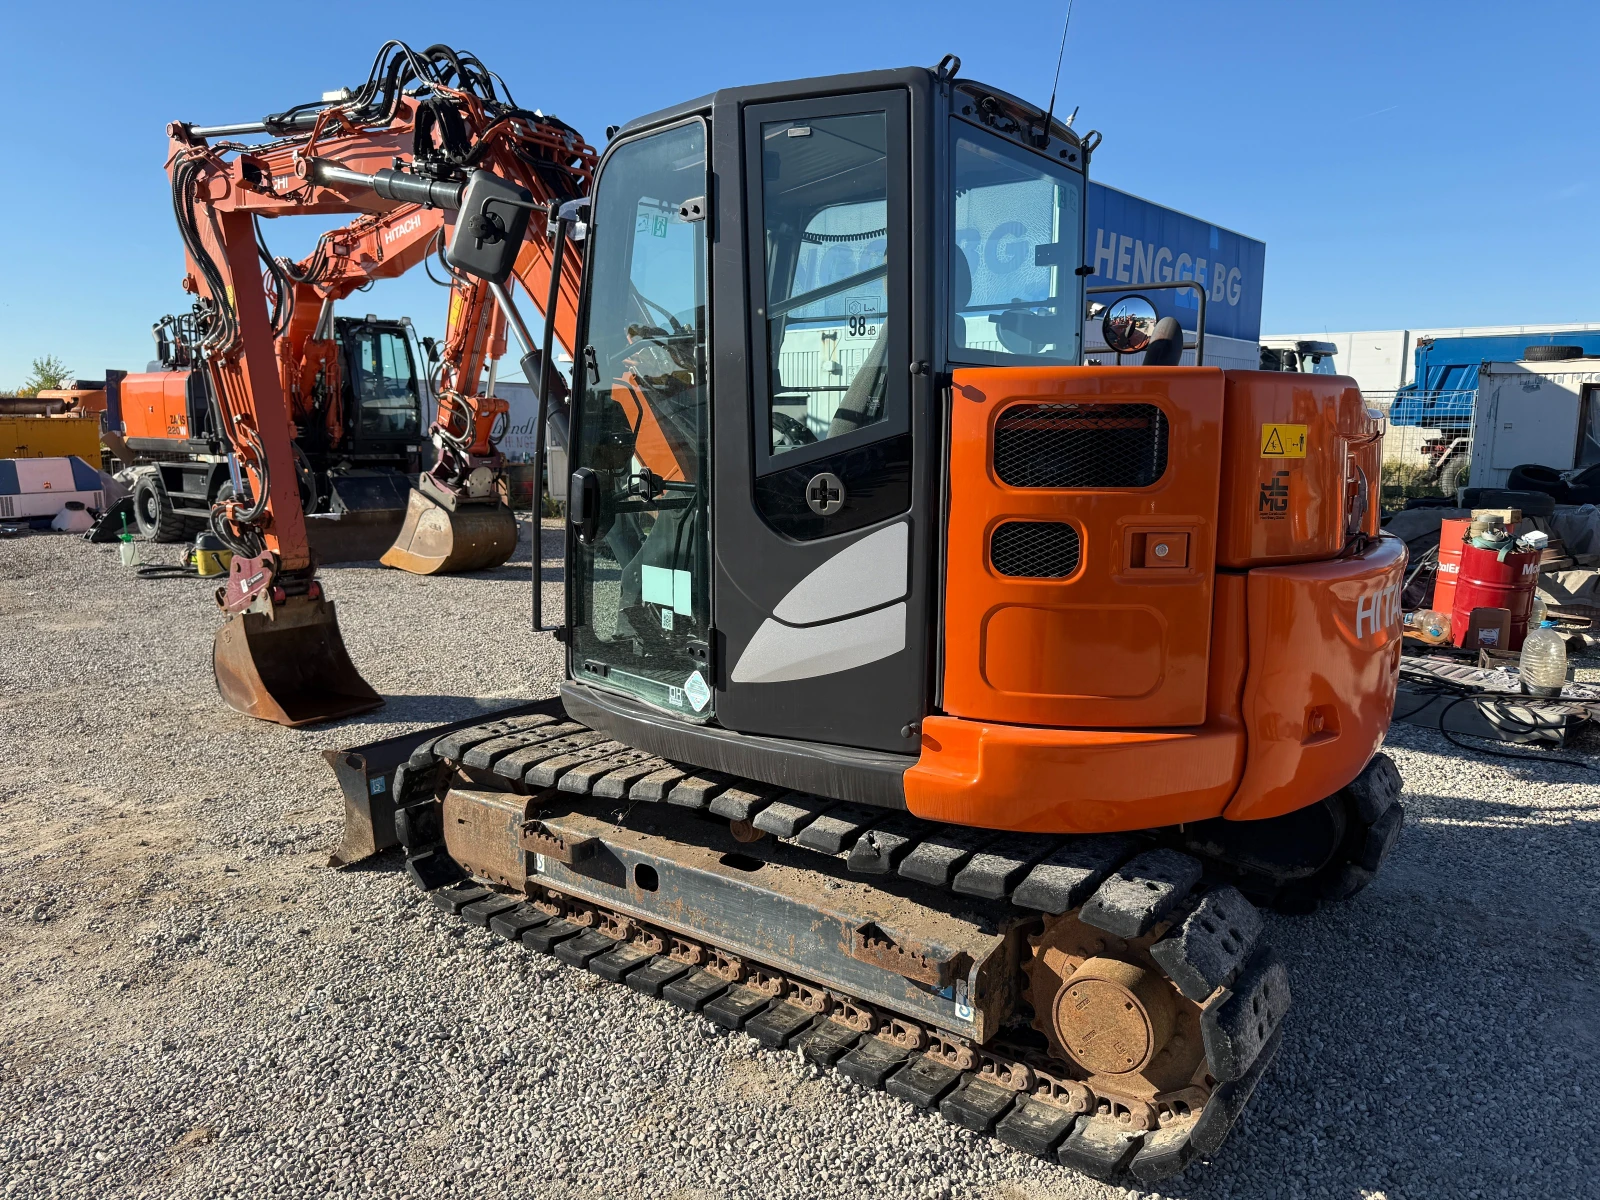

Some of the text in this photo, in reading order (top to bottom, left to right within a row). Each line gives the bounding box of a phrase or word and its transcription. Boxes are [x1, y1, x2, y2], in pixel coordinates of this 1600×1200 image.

[384, 214, 422, 245] HITACHI
[849, 316, 877, 336] 98 dB
[167, 425, 187, 436] 220W
[1355, 581, 1402, 639] HITA
